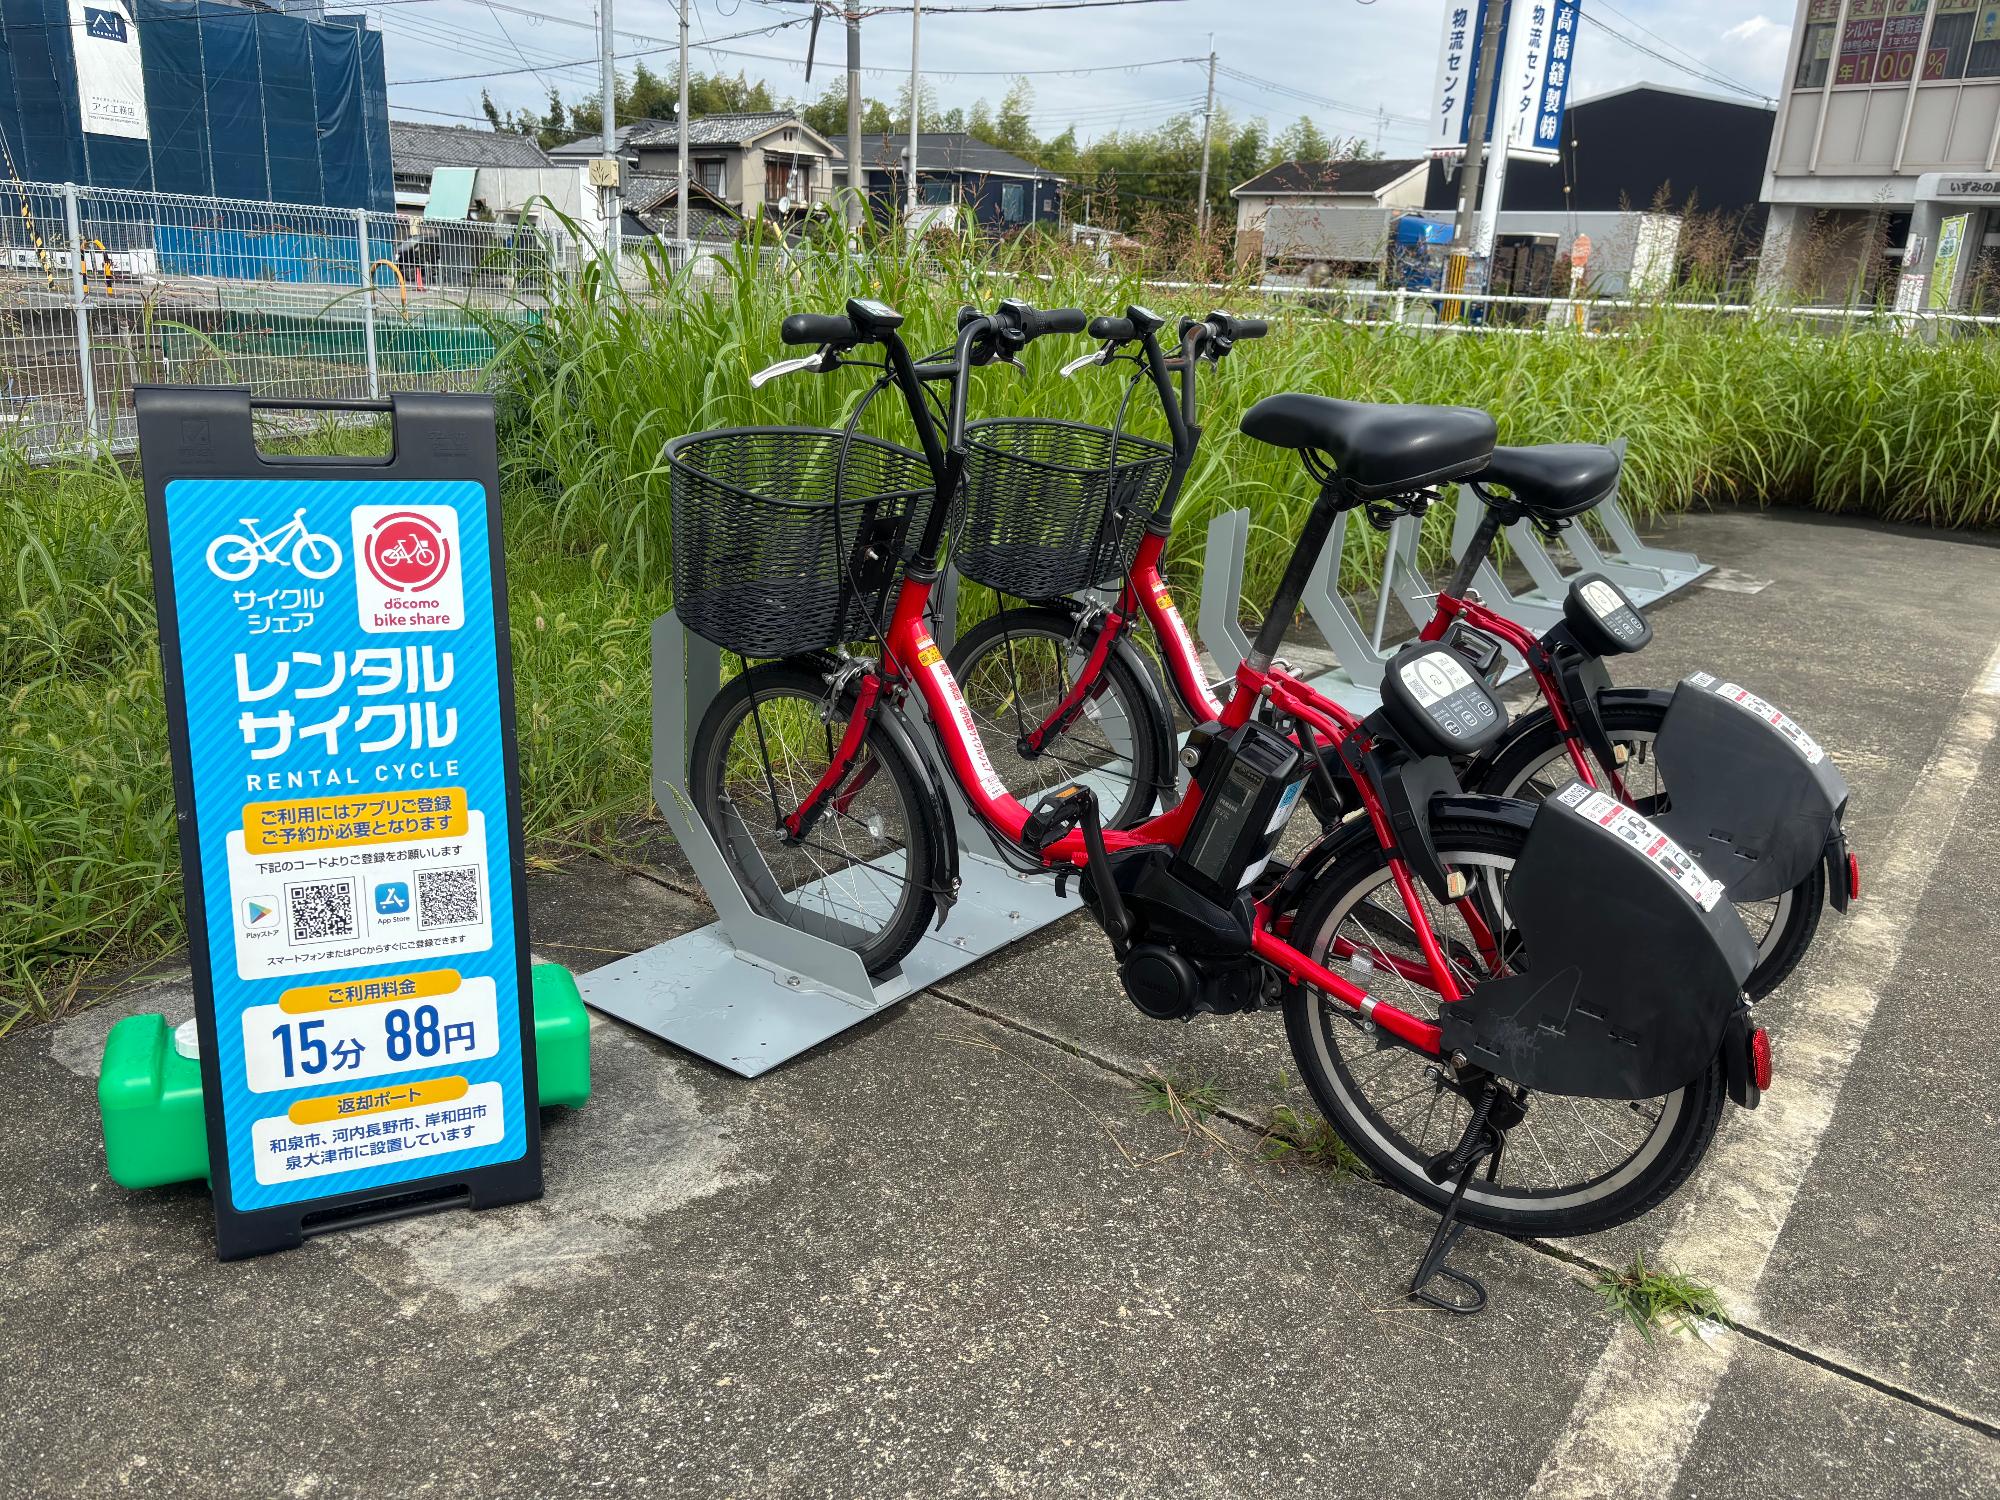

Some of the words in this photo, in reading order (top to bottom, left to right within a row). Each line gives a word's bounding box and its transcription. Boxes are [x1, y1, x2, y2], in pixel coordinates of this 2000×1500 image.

[1441, 8, 1468, 136] 物流センター
[1518, 5, 1546, 136] 物流センター
[92, 102, 135, 117] アイ工務店
[233, 588, 325, 611] サイクル
[248, 612, 314, 635] シェア
[374, 613, 407, 627] bike
[409, 612, 450, 626] share
[234, 645, 455, 703] レンタル
[238, 701, 458, 760] サイクル
[246, 767, 360, 792] RENTAL
[375, 759, 460, 782] CYCLE
[260, 795, 452, 827] ご利用にはアプリご登録
[262, 814, 453, 846] ご予約が必要となります
[255, 844, 464, 875] 下記のコードよりご登録をお願いします
[246, 929, 280, 940] Playストア
[377, 916, 392, 925] App
[392, 914, 411, 923] Store
[267, 935, 467, 966] スマートフォンまたはPCからすぐにご登録できます
[328, 978, 416, 1004] ご利用料金
[272, 1019, 366, 1078] 15分
[384, 1004, 476, 1062] 88円
[337, 1087, 422, 1114] 返却ポート
[269, 1104, 487, 1154] 和泉市、河内長野市、岸和田市
[285, 1124, 476, 1171] 泉大津市に設置しています
